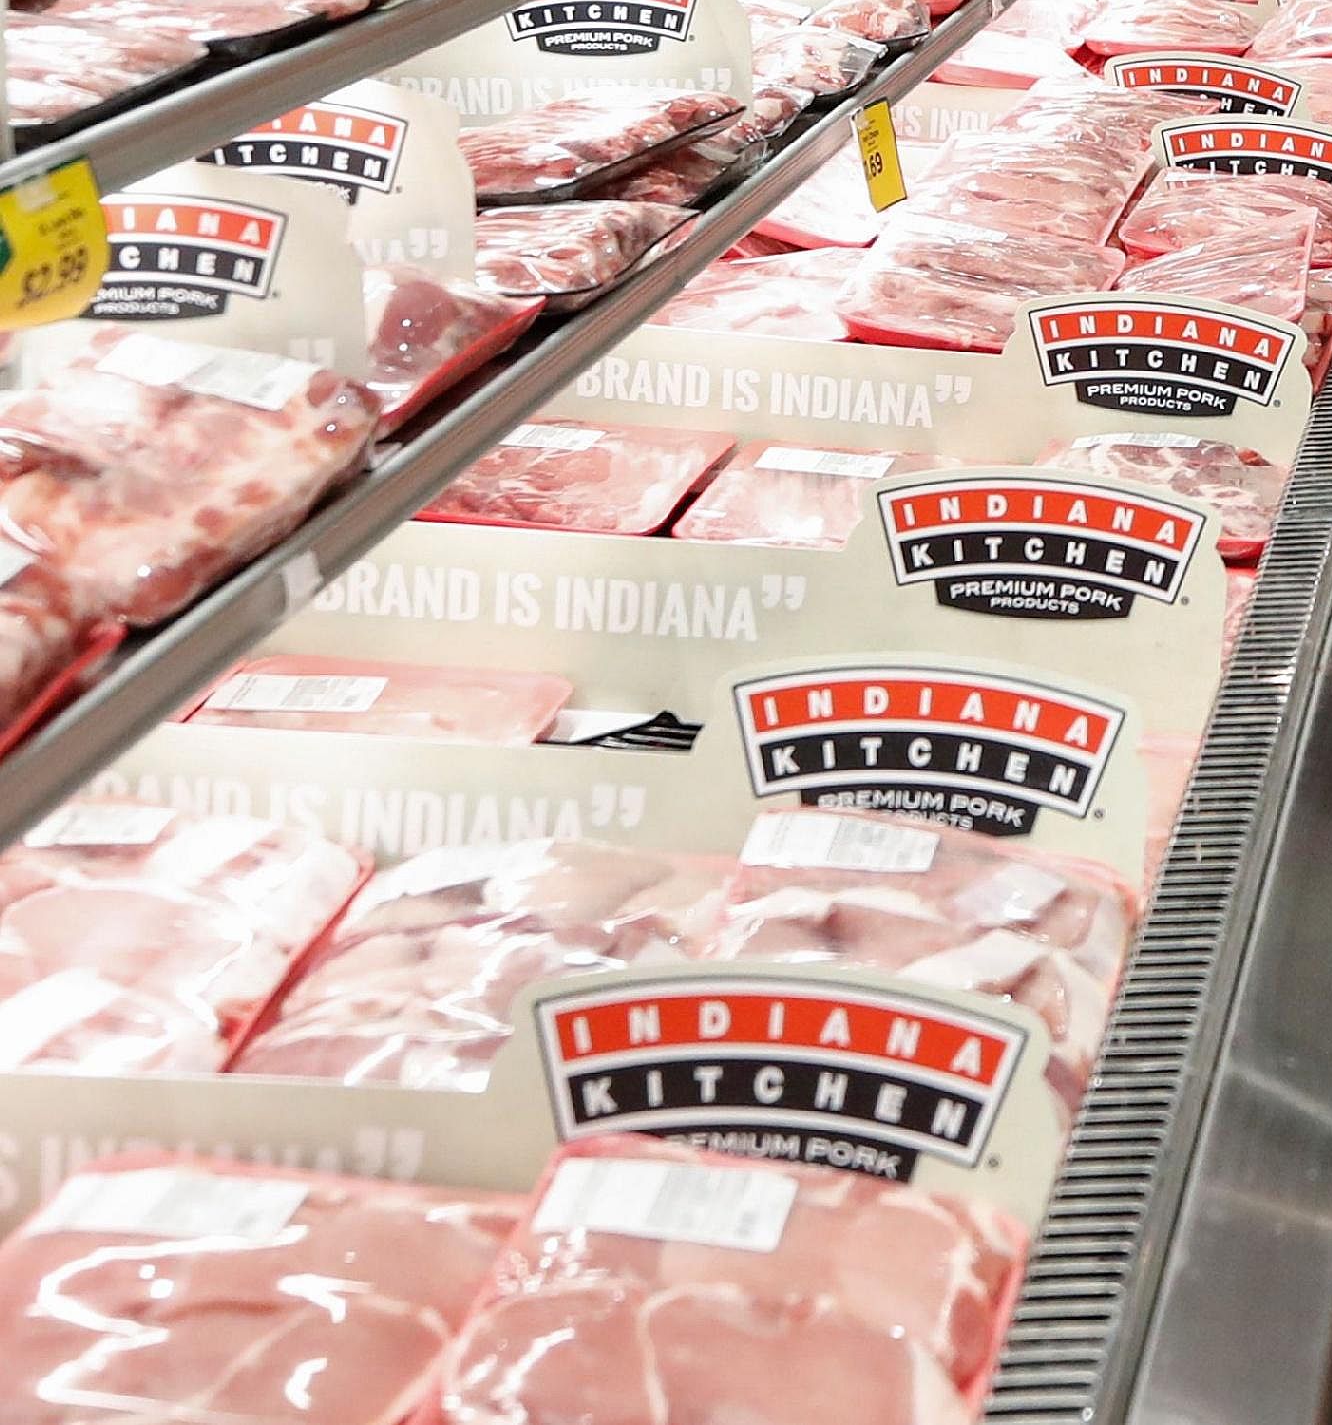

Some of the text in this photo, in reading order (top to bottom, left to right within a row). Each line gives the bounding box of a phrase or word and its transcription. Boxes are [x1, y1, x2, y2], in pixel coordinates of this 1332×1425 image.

[518, 5, 678, 31] KITCHEN
[545, 32, 653, 48] PREMIUM PORK
[571, 42, 628, 51] PRODUCTS
[1128, 69, 1284, 102] INDIANA
[214, 143, 382, 178] ITCHEN
[121, 206, 261, 245] IANA
[119, 244, 256, 283] CHEN
[157, 288, 219, 309] PORK
[1050, 315, 1272, 358] INDIANA
[575, 357, 710, 408] BRAND
[721, 367, 762, 413] IS
[1056, 349, 1261, 390] KITCHEN
[1087, 384, 1227, 410] PREMIUM PORK
[1119, 396, 1192, 411] PRODUCTS
[902, 494, 1175, 544] INDIANA
[911, 537, 1165, 585] KITCHEN
[495, 570, 542, 628] IS
[950, 580, 1124, 611] PREMIUM PORK
[990, 597, 1080, 615] PRODUCTS
[762, 683, 1090, 745] INDIANA
[773, 741, 1078, 795] KITCHEN
[817, 789, 1026, 828] PREMIUM PORK
[569, 1001, 981, 1077] INDIANA
[583, 1064, 969, 1148] KITCHEN
[806, 1137, 902, 1179] PORK
